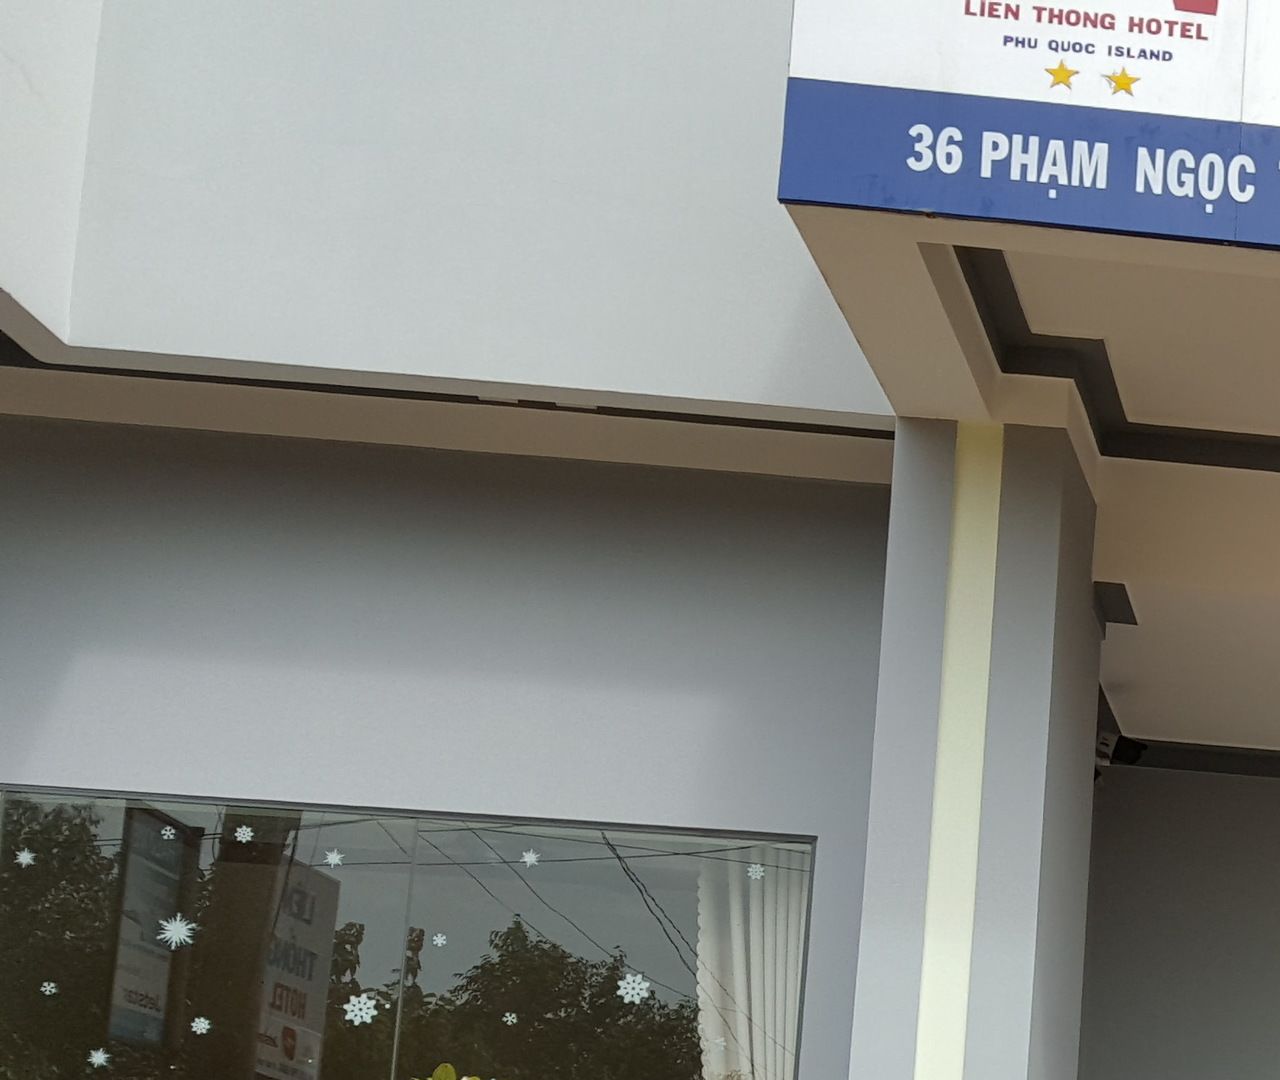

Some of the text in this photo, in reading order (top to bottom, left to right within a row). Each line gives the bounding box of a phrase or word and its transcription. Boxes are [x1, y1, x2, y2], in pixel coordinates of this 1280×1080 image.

[964, 0, 1208, 41] LIEN THONG HOTEL
[1002, 34, 1173, 62] PHU QUOC ISLAND
[906, 123, 963, 174] 36
[981, 131, 1109, 200] PHẠM
[1136, 146, 1256, 214] NGỌC
